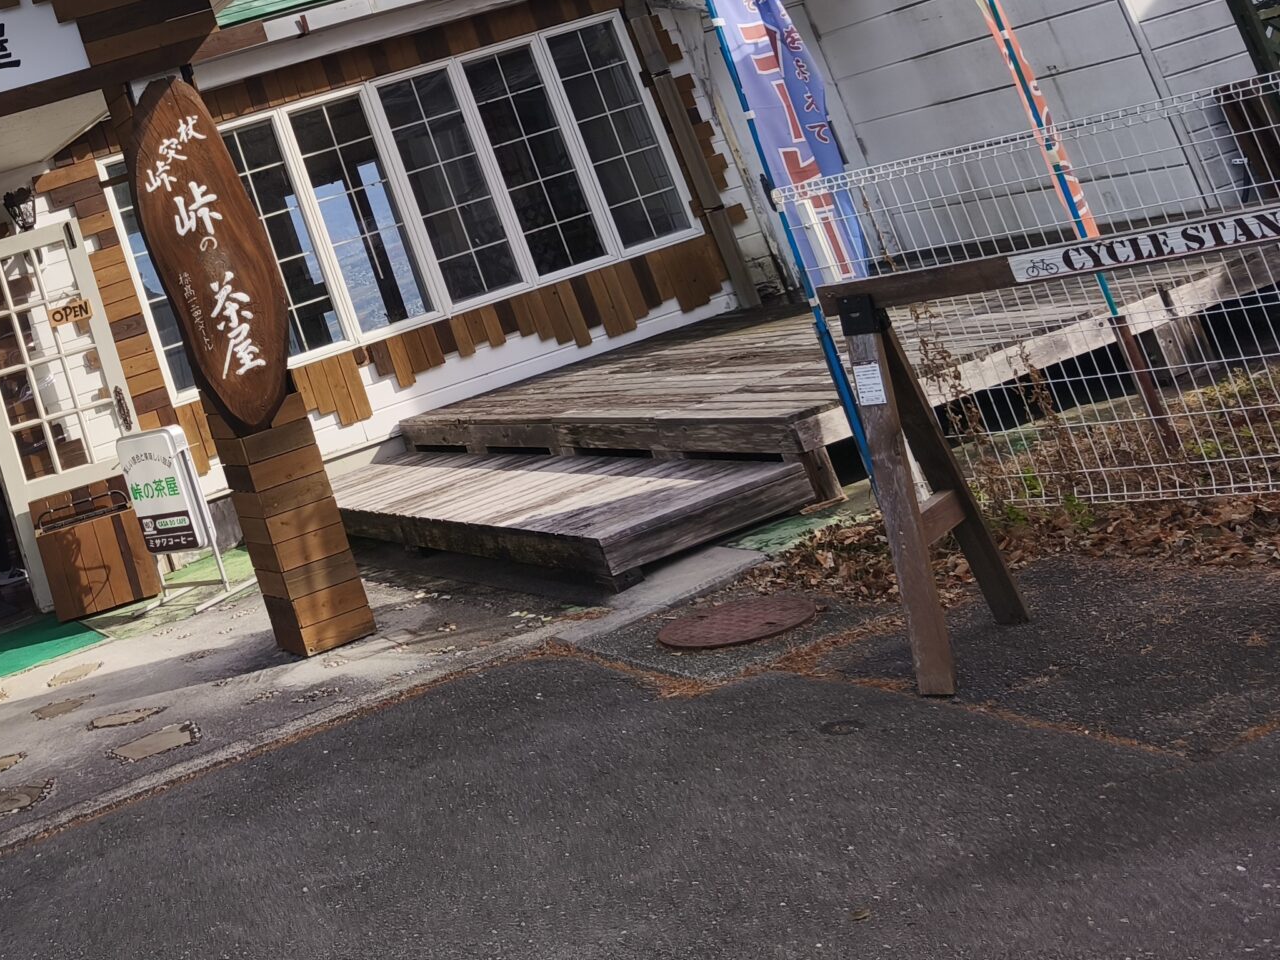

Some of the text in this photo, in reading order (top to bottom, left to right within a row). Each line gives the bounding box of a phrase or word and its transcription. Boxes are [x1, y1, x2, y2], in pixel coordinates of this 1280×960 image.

[1061, 210, 1280, 272] CYCLE STAN
[174, 180, 266, 380] 峠の茶屋
[52, 301, 90, 324] OPEN
[130, 476, 181, 502] 峠の茶屋
